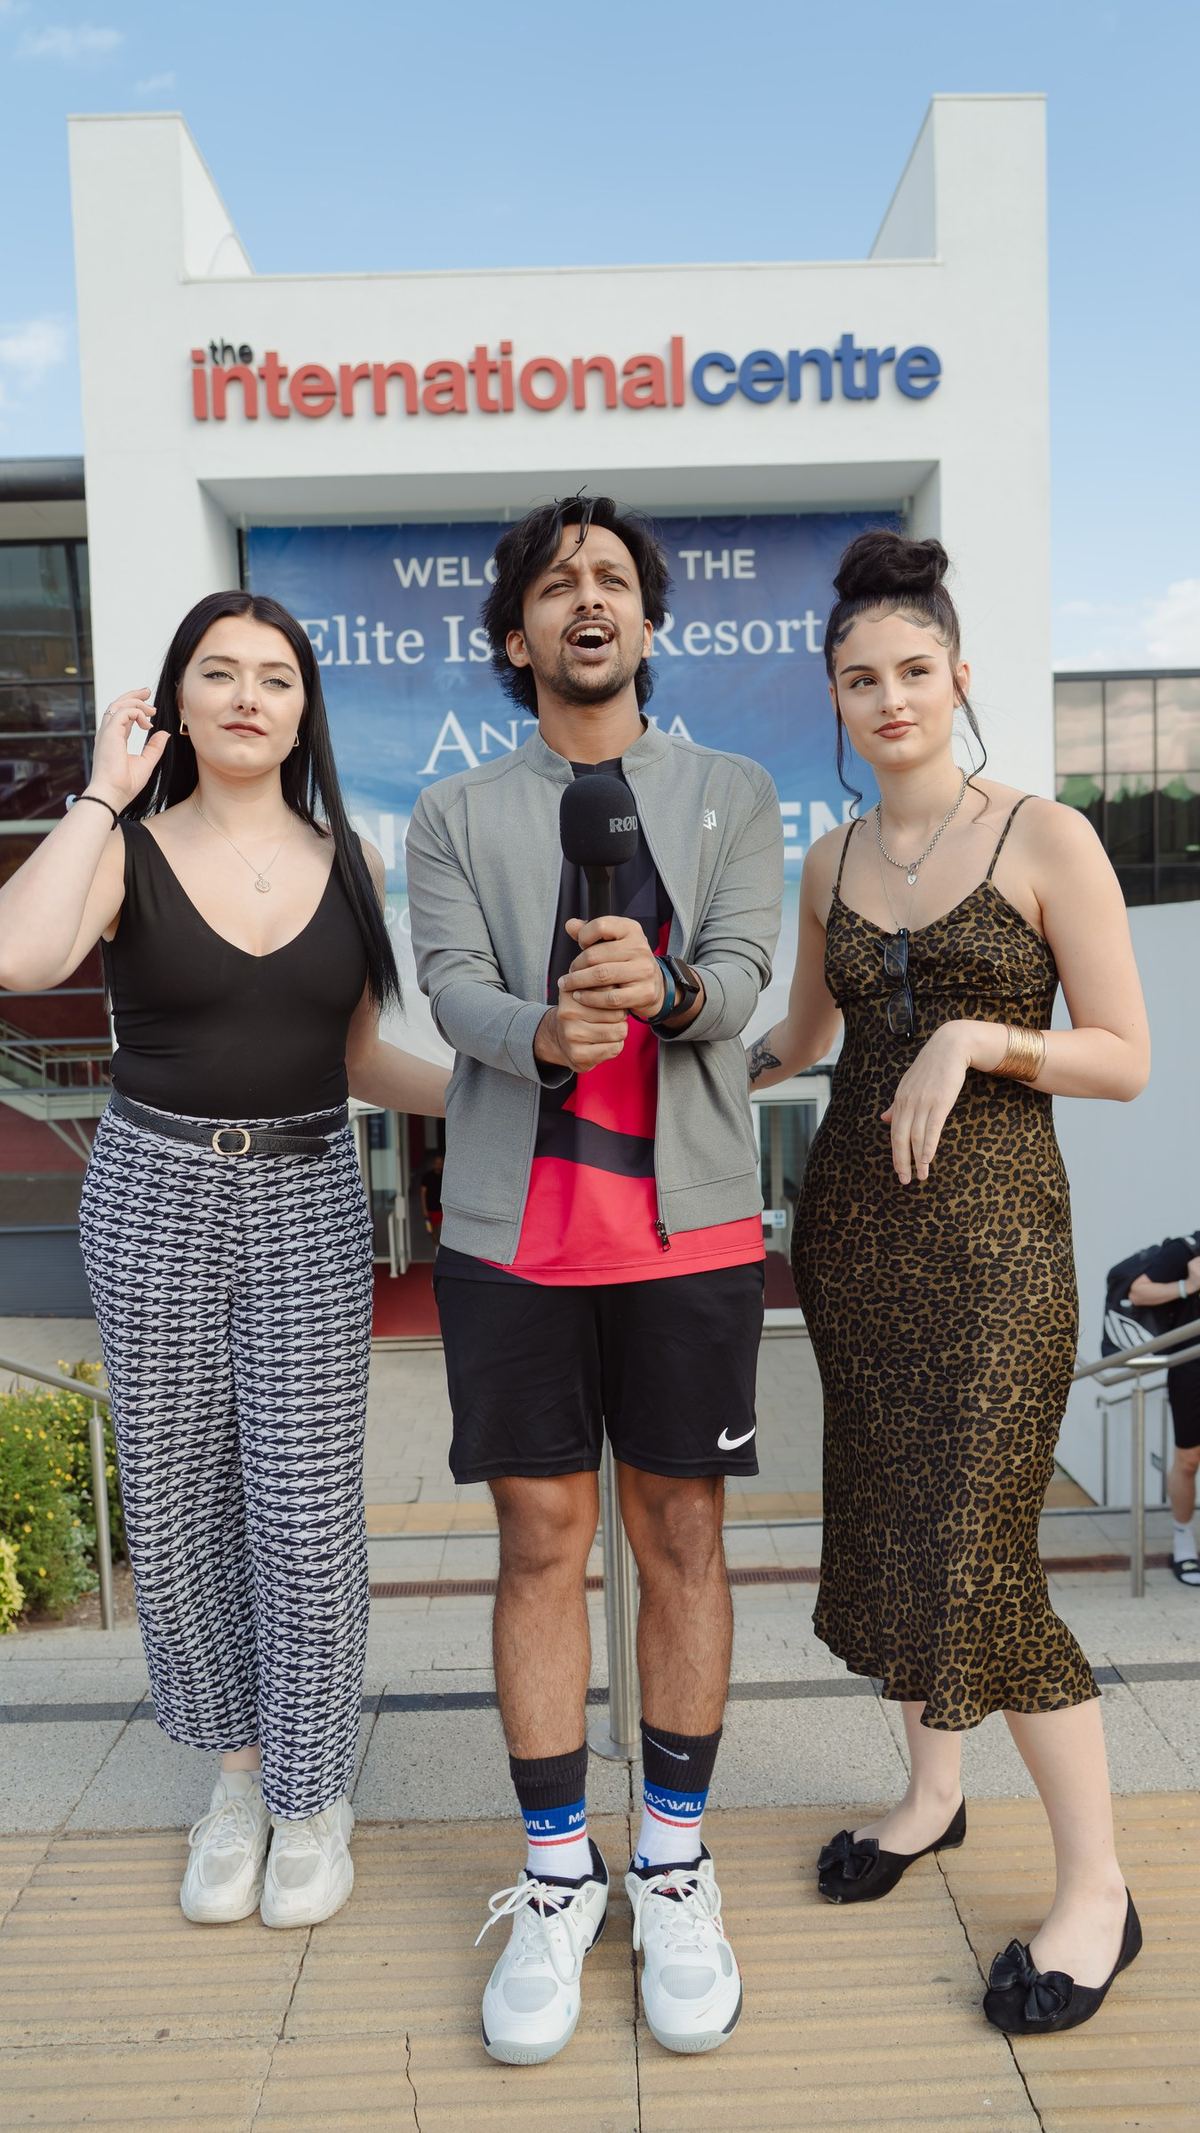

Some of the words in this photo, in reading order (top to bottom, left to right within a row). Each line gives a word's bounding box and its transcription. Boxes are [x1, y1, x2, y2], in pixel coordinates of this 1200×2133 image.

[208, 337, 254, 365] the
[678, 548, 757, 580] THE
[298, 615, 425, 665] Elite
[568, 1808, 586, 1825] MA
